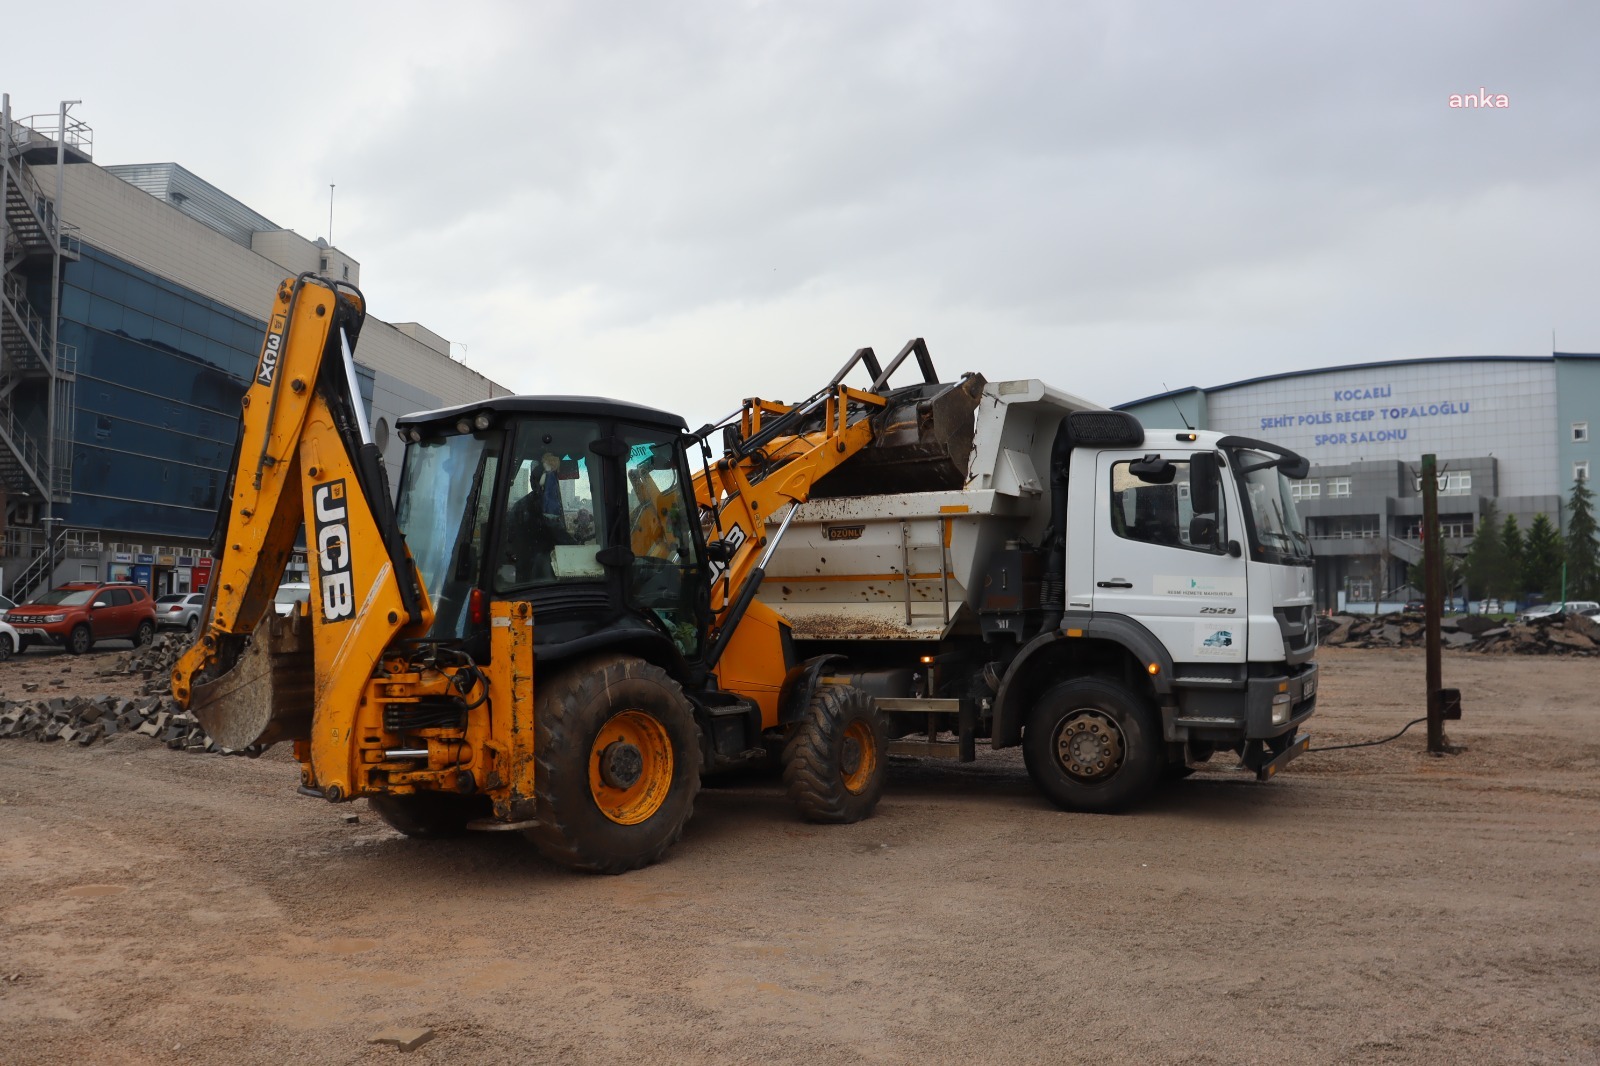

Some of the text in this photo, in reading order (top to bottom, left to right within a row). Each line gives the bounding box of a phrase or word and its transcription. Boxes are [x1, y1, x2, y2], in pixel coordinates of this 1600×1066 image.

[258, 333, 281, 381] 3CX
[1334, 384, 1391, 402] KOCAELİ
[1261, 401, 1470, 430] ŞEHİT POLİS RECEP TOPALOĞLU
[1315, 429, 1407, 446] SPOR SALONU
[315, 486, 353, 620] JCB
